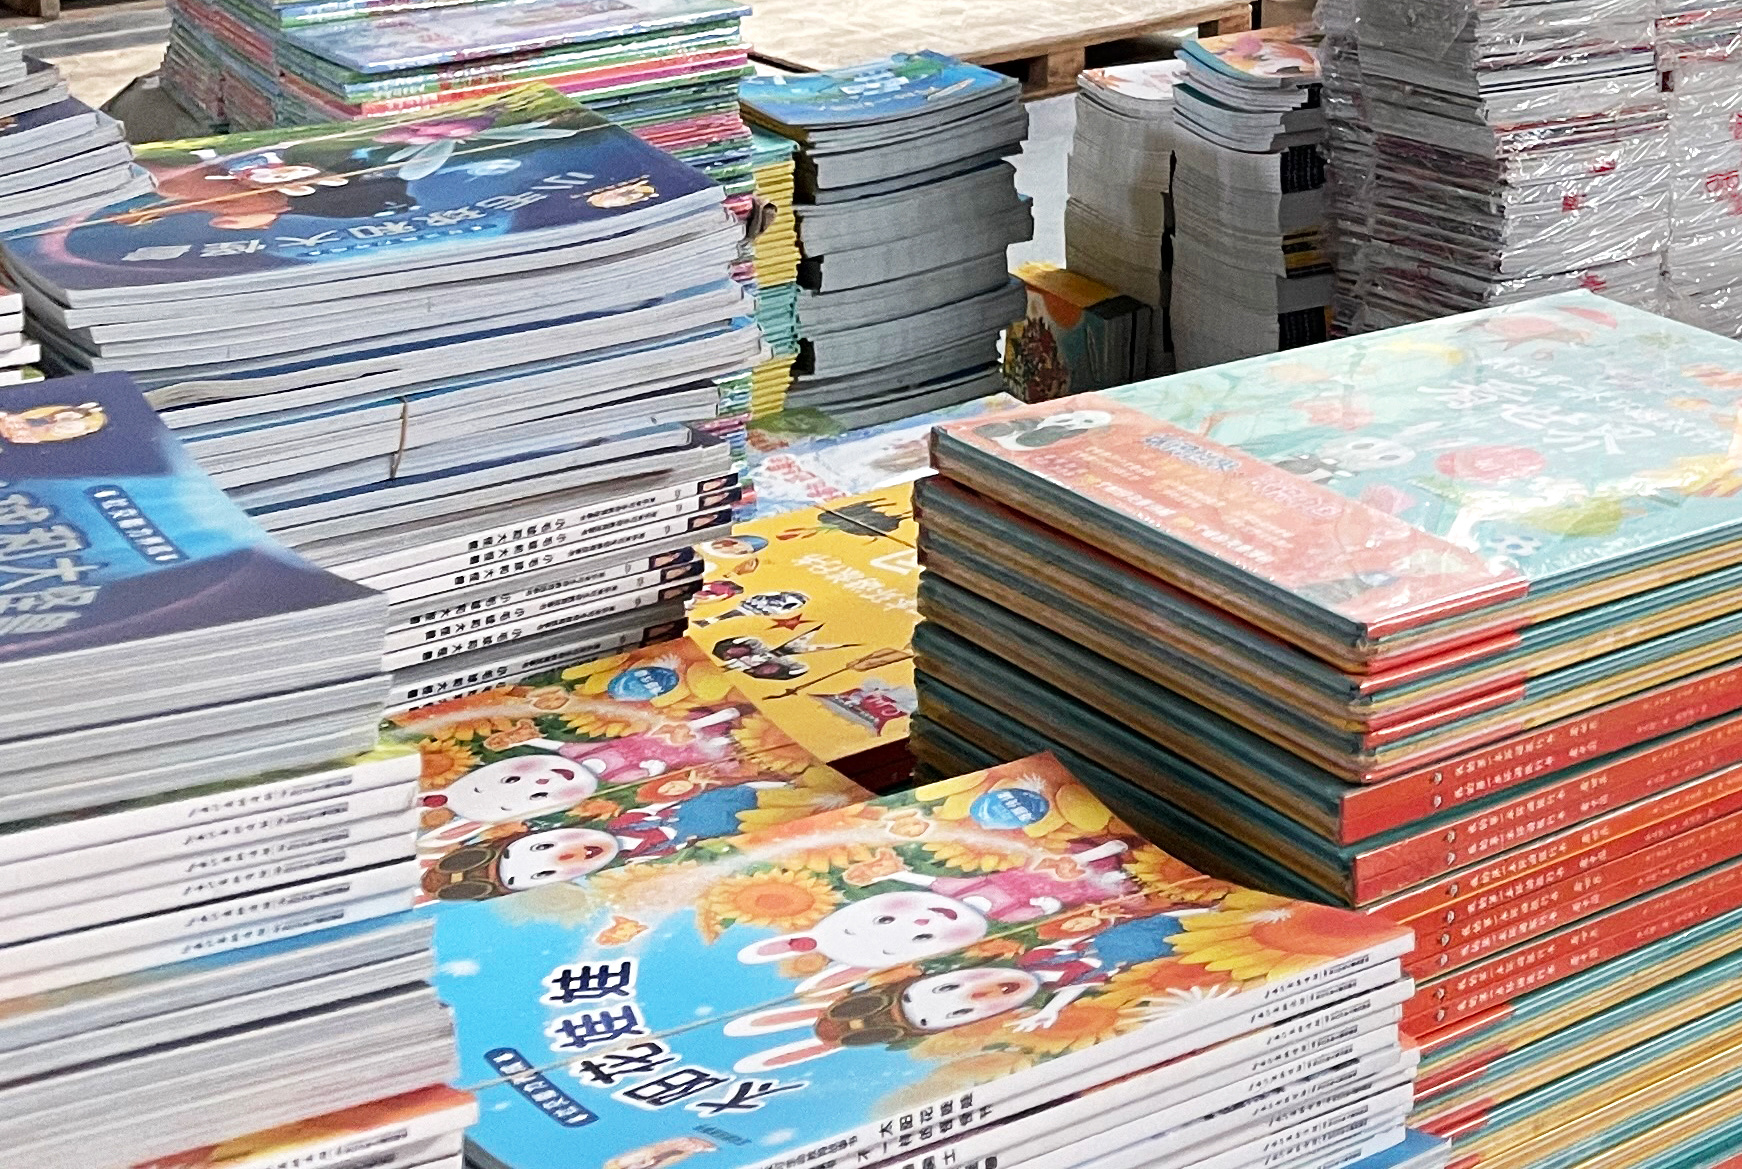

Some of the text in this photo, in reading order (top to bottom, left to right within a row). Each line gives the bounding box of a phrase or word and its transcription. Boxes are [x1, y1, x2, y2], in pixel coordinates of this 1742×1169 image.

[553, 960, 805, 1115] 太阳花娃娃
